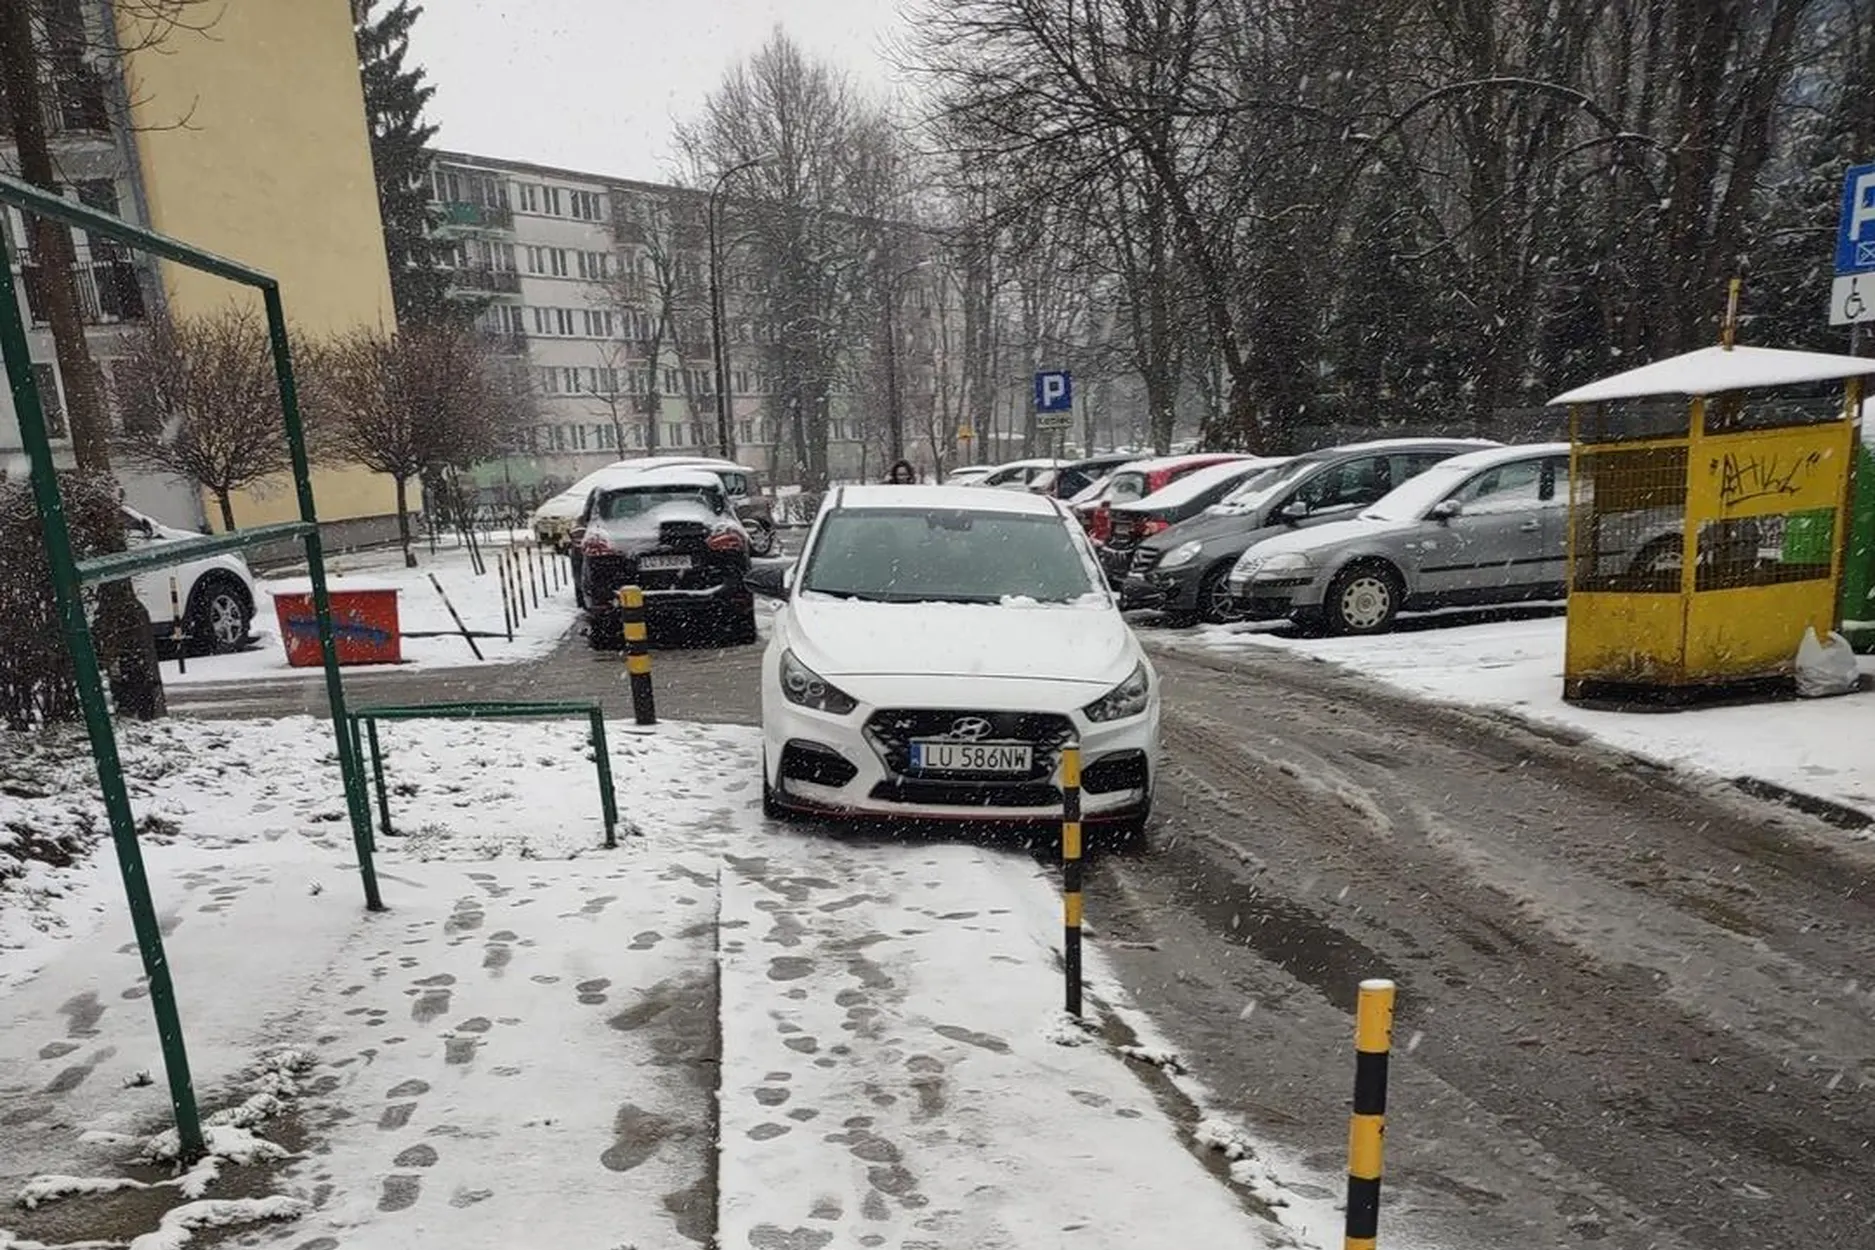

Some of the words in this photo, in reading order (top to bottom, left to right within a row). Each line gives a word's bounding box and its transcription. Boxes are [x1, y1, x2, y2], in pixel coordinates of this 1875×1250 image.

[1043, 375, 1065, 406] P
[926, 746, 952, 767] LU
[961, 748, 1027, 768] 586NW
